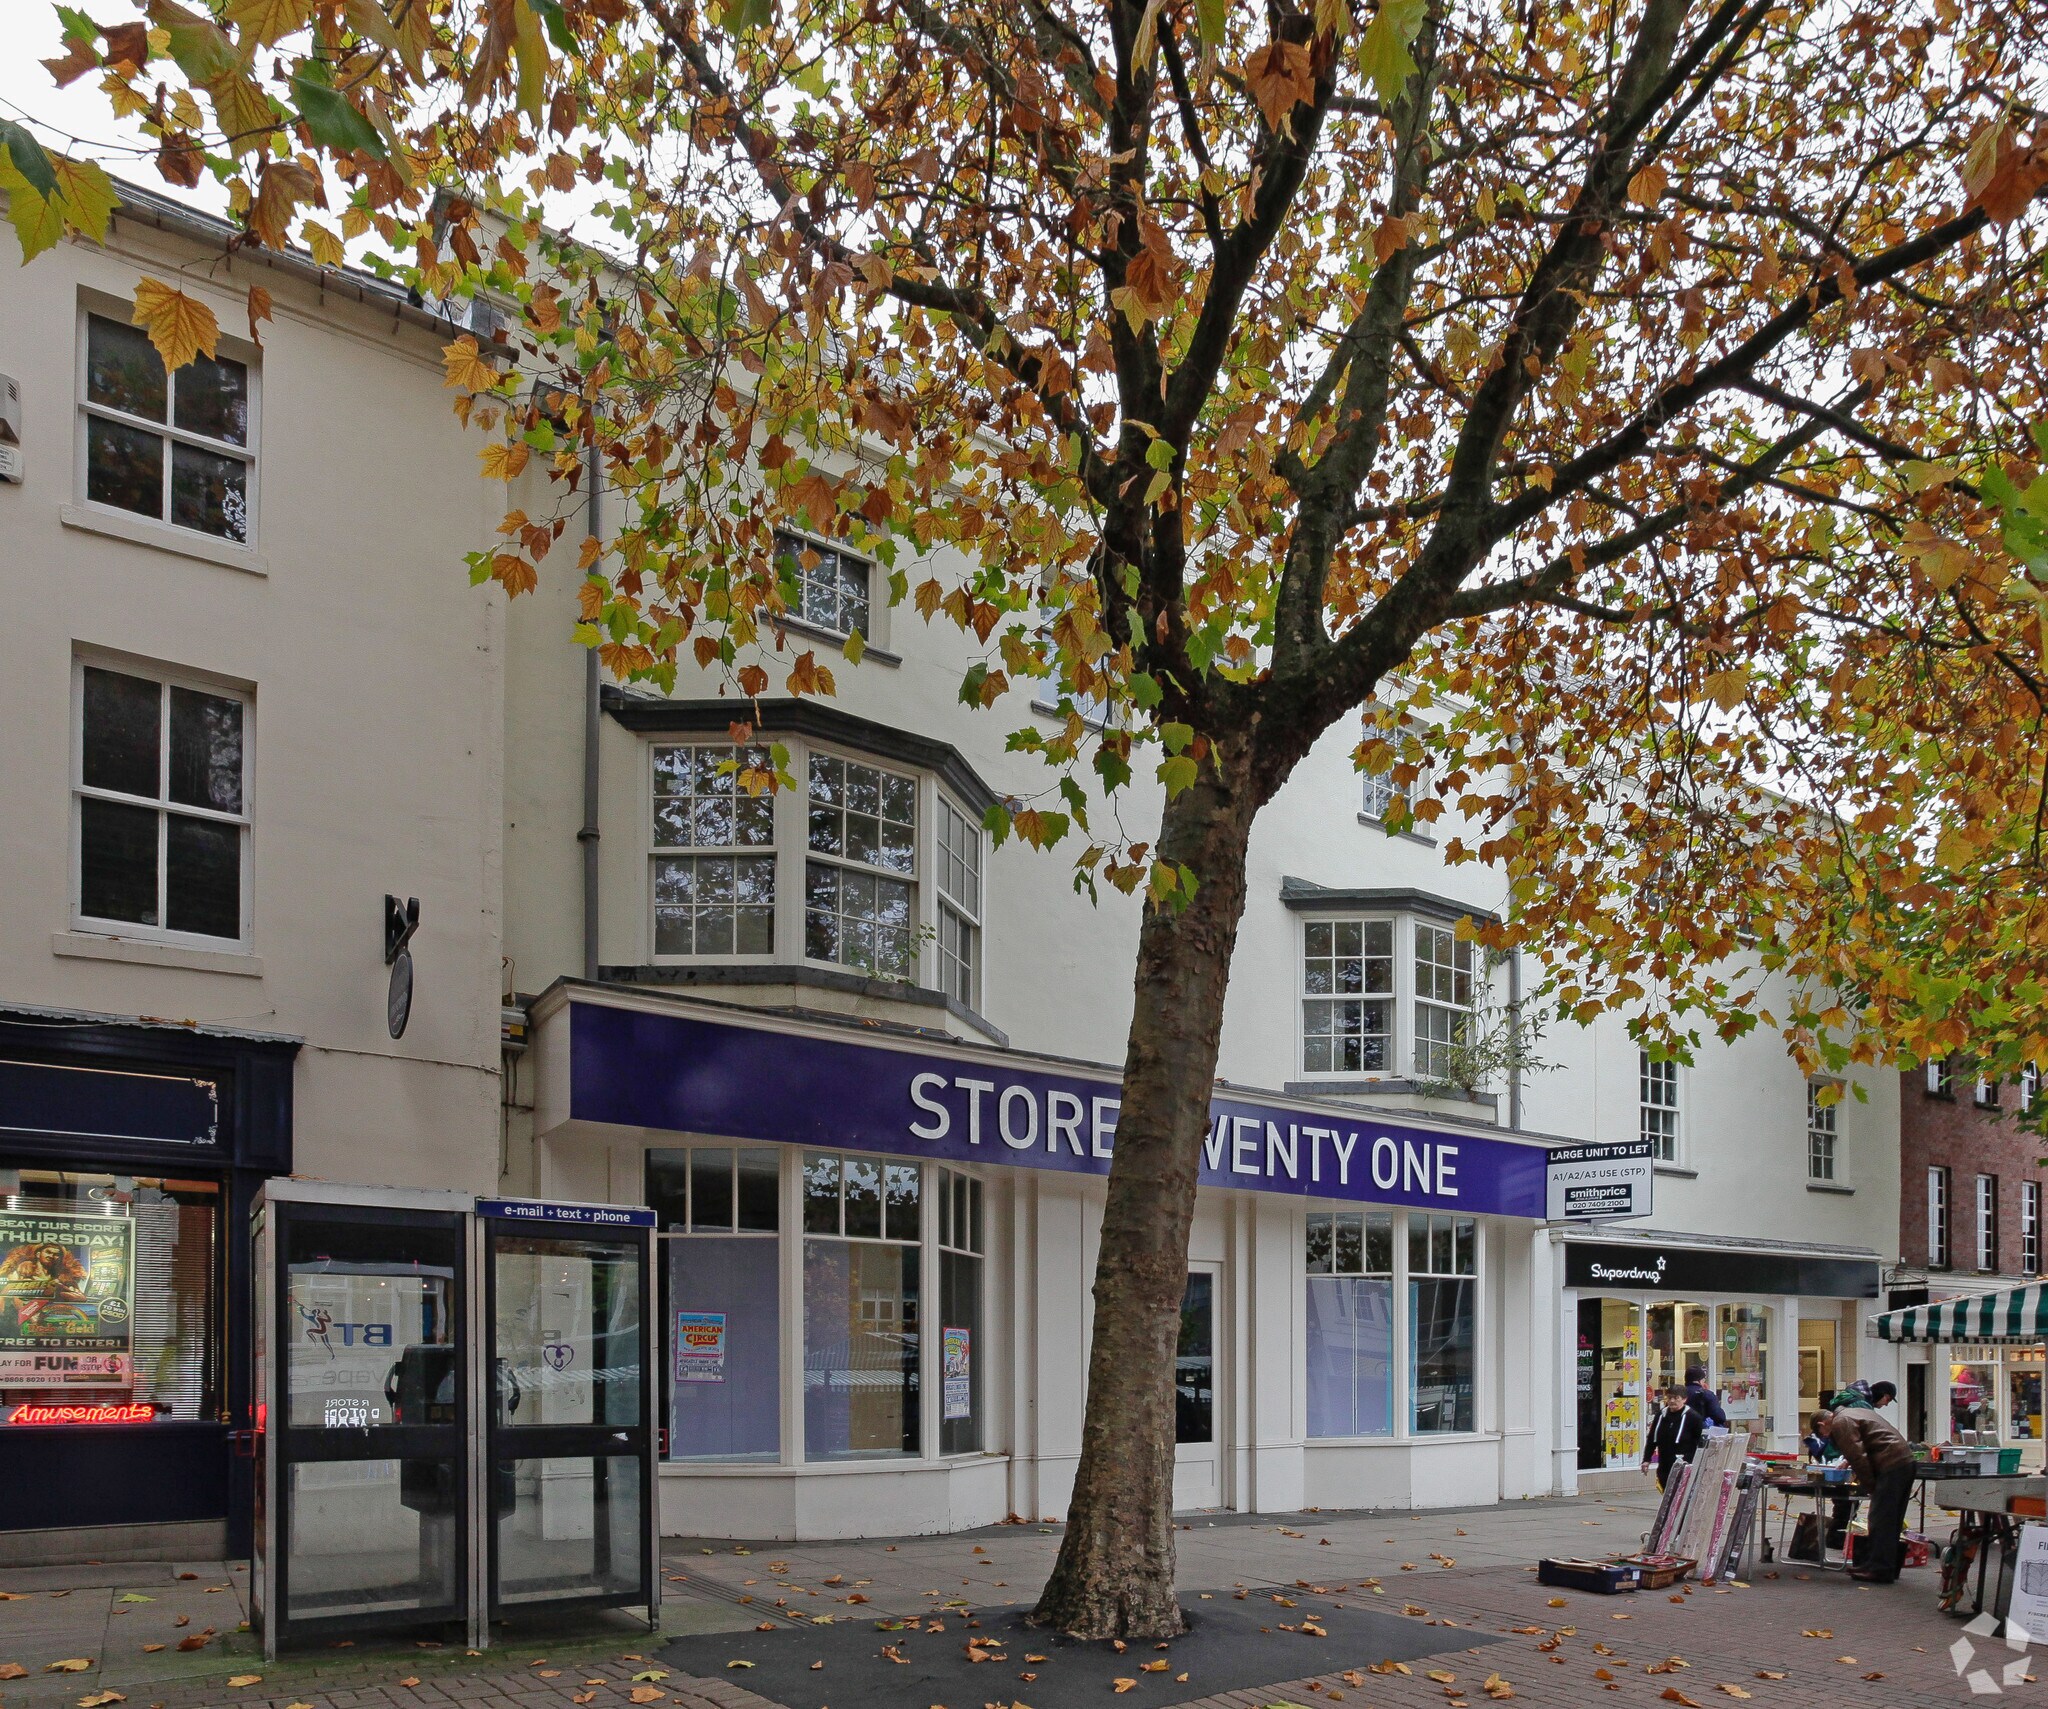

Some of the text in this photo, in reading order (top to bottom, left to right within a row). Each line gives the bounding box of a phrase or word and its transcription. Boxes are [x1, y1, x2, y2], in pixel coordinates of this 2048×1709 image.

[908, 1072, 1459, 1196] STORE ENTY ONE
[1551, 1144, 1648, 1160] LARGE UNIT TO LET
[1553, 1167, 1646, 1181] A1/A2/A3 USE (STP)
[1570, 1187, 1626, 1199] smithprice
[504, 1206, 544, 1216] e-mail
[557, 1208, 581, 1219] text
[593, 1211, 630, 1222] phone
[39, 1222, 70, 1232] OUR
[1591, 1263, 1661, 1283] Superdrug
[682, 1325, 723, 1335] AMERICAN
[40, 1338, 61, 1346] TO
[65, 1339, 121, 1347] ENTER!
[685, 1333, 718, 1346] CIRCUS
[34, 1356, 78, 1371] FUN
[10, 1403, 153, 1424] Amusements
